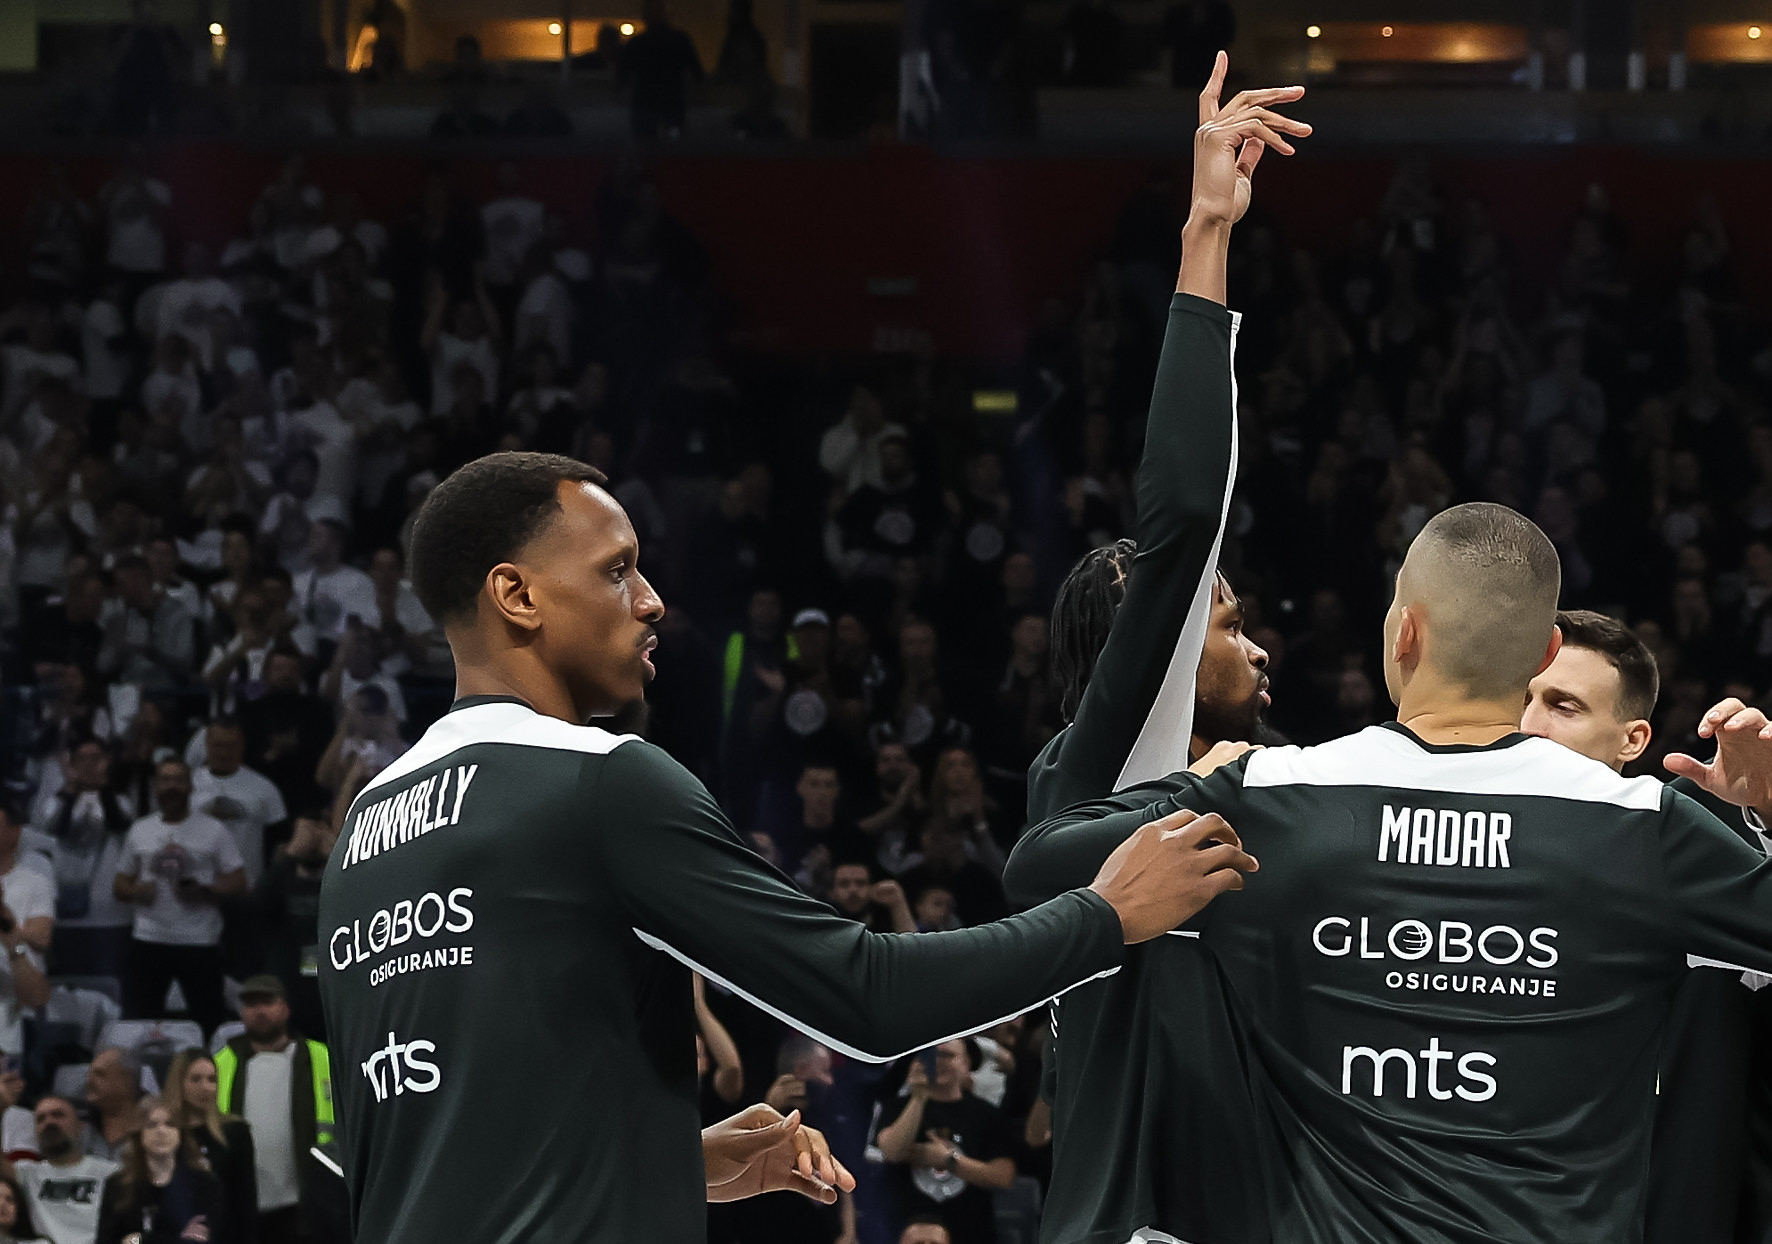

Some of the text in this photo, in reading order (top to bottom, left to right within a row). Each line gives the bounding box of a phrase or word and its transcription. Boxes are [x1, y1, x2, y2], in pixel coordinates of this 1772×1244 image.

[342, 763, 479, 871] NUNNALLY
[1377, 804, 1513, 868] MADAR
[330, 887, 474, 971] GLOBOS
[1312, 916, 1559, 969] GLOBOS
[370, 946, 474, 987] OSIGURANJE
[1385, 971, 1557, 997] OSIGURANJE
[1342, 1037, 1497, 1102] mts
